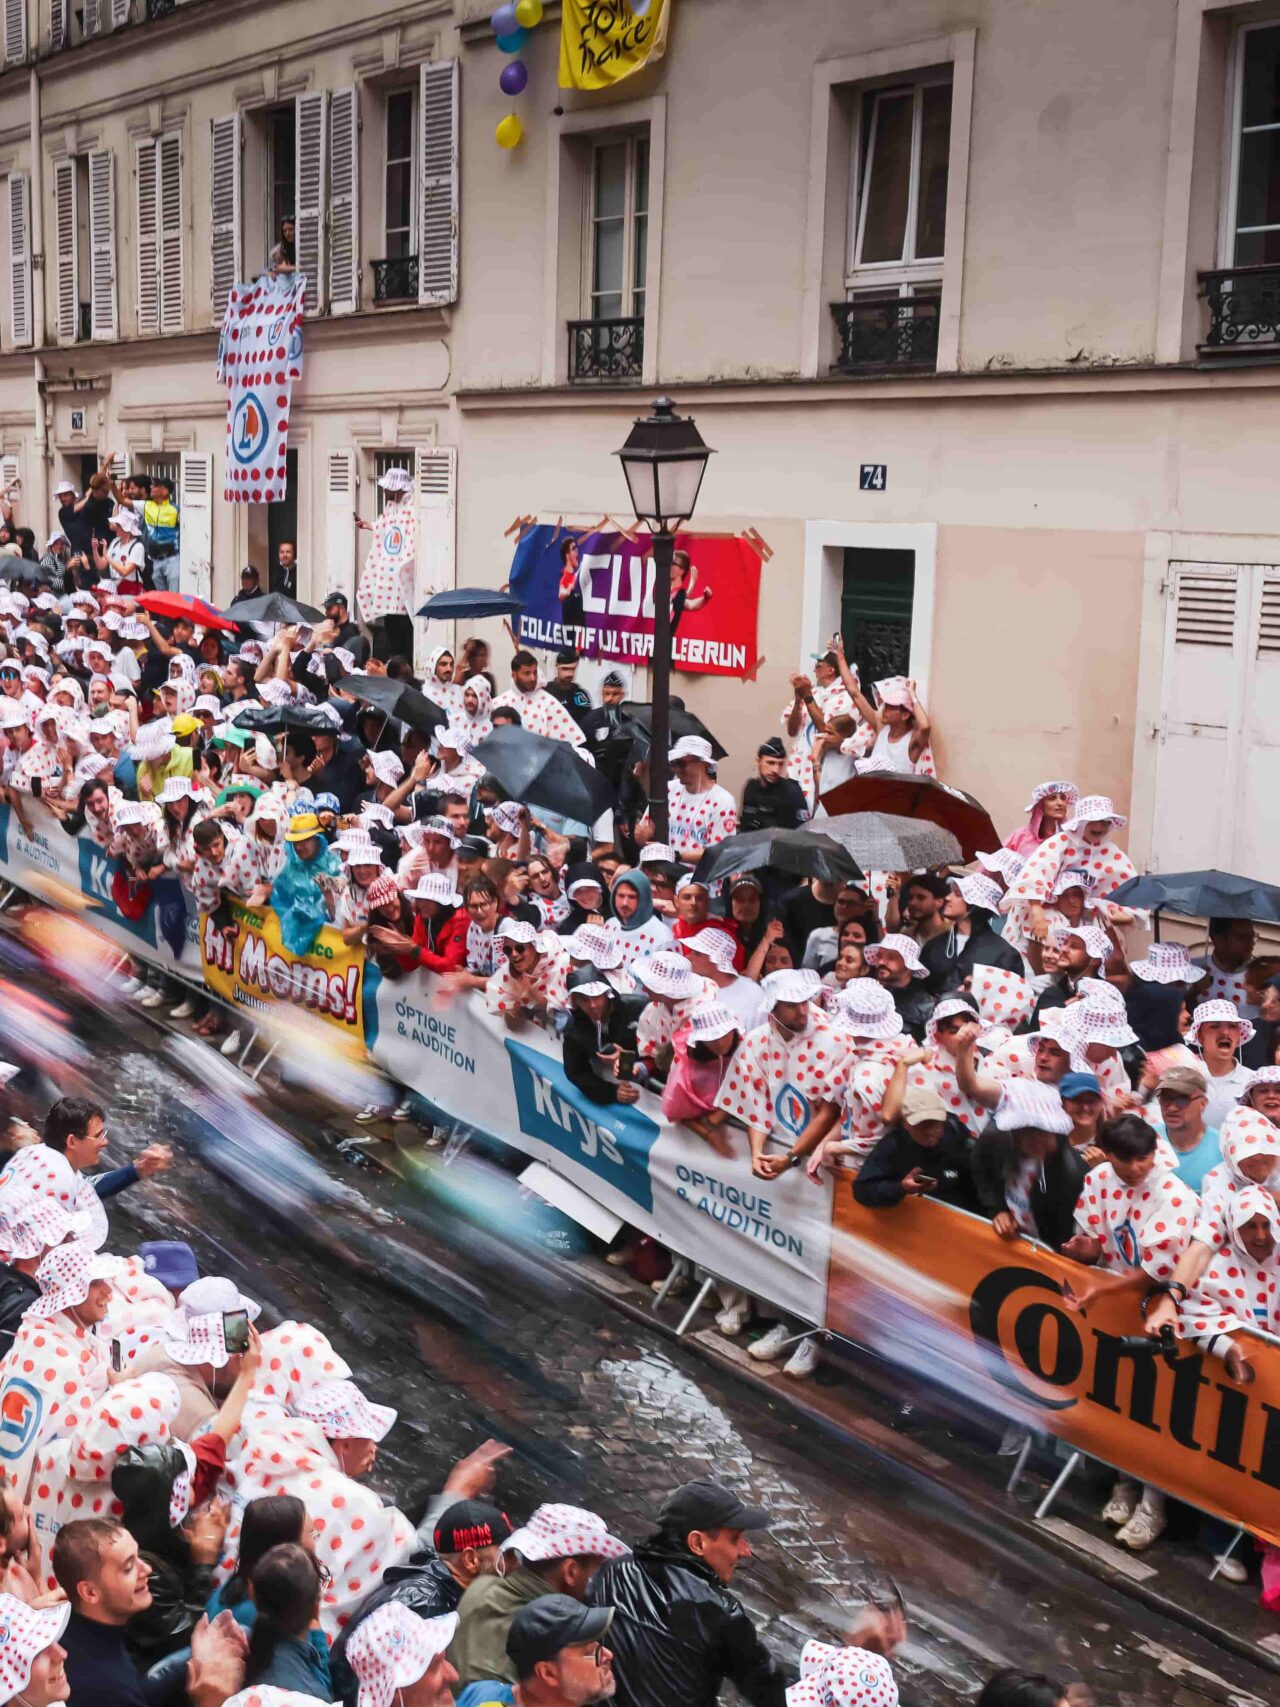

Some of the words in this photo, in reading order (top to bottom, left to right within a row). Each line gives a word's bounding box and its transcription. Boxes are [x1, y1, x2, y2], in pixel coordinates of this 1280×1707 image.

[72, 412, 83, 429] 76
[864, 466, 883, 489] 74
[520, 615, 596, 650] COLLECTIF
[599, 629, 655, 657] ULTRA
[671, 636, 746, 670] LEBRUN
[239, 931, 360, 1025] Moms!
[395, 1001, 457, 1044] OPTIQUE
[397, 1021, 408, 1037] &
[412, 1031, 475, 1075] AUDITION
[530, 1067, 625, 1166] Krys
[676, 1164, 773, 1221] OPTIQUE
[676, 1187, 691, 1203] &
[697, 1198, 804, 1257] AUDITION
